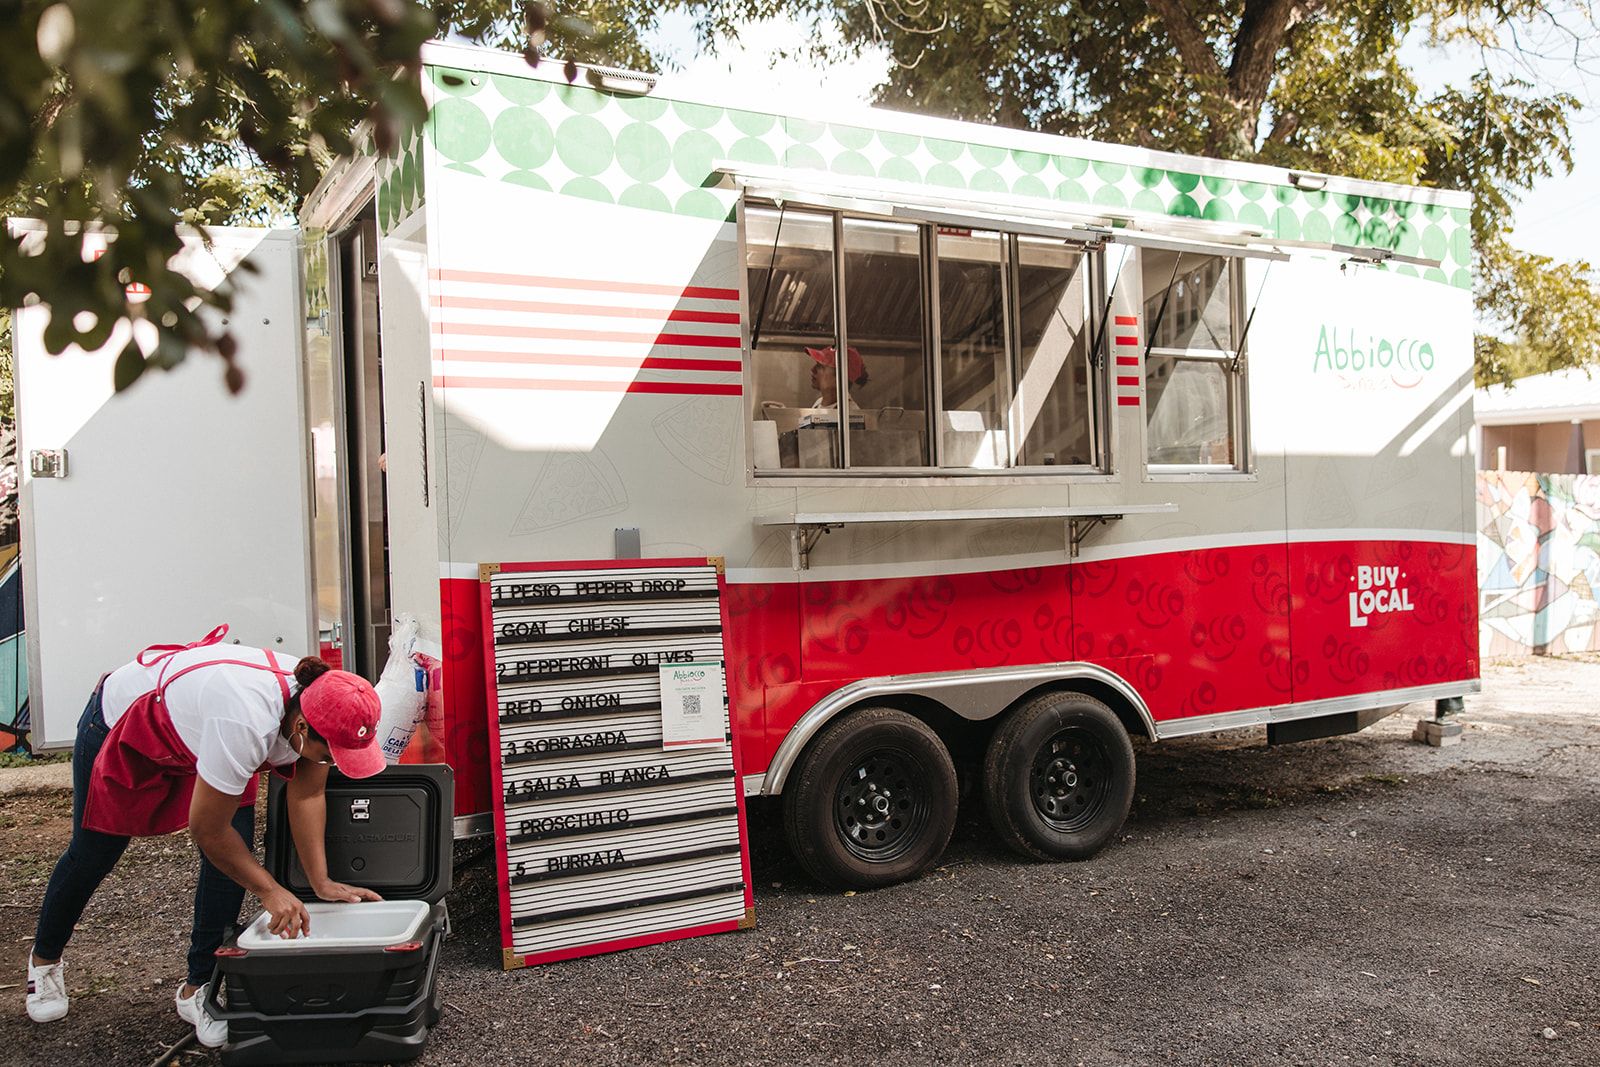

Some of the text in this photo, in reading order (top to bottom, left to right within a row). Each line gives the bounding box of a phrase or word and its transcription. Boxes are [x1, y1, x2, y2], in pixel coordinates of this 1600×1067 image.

[1313, 324, 1434, 373] Abbiocco
[576, 581, 633, 596] PEPPER
[642, 579, 686, 593] DROP
[1357, 565, 1399, 590] BUY
[1349, 588, 1414, 627] LOCAL
[501, 616, 631, 637] GOAT CHEESE
[496, 663, 506, 677] 2
[673, 670, 705, 680] Abbiocco
[506, 699, 542, 716] RED
[507, 730, 628, 756] 3 SOBRASADA
[507, 765, 670, 796] 4 SALSA BLANCA
[515, 849, 625, 877] 5 BURRATA
